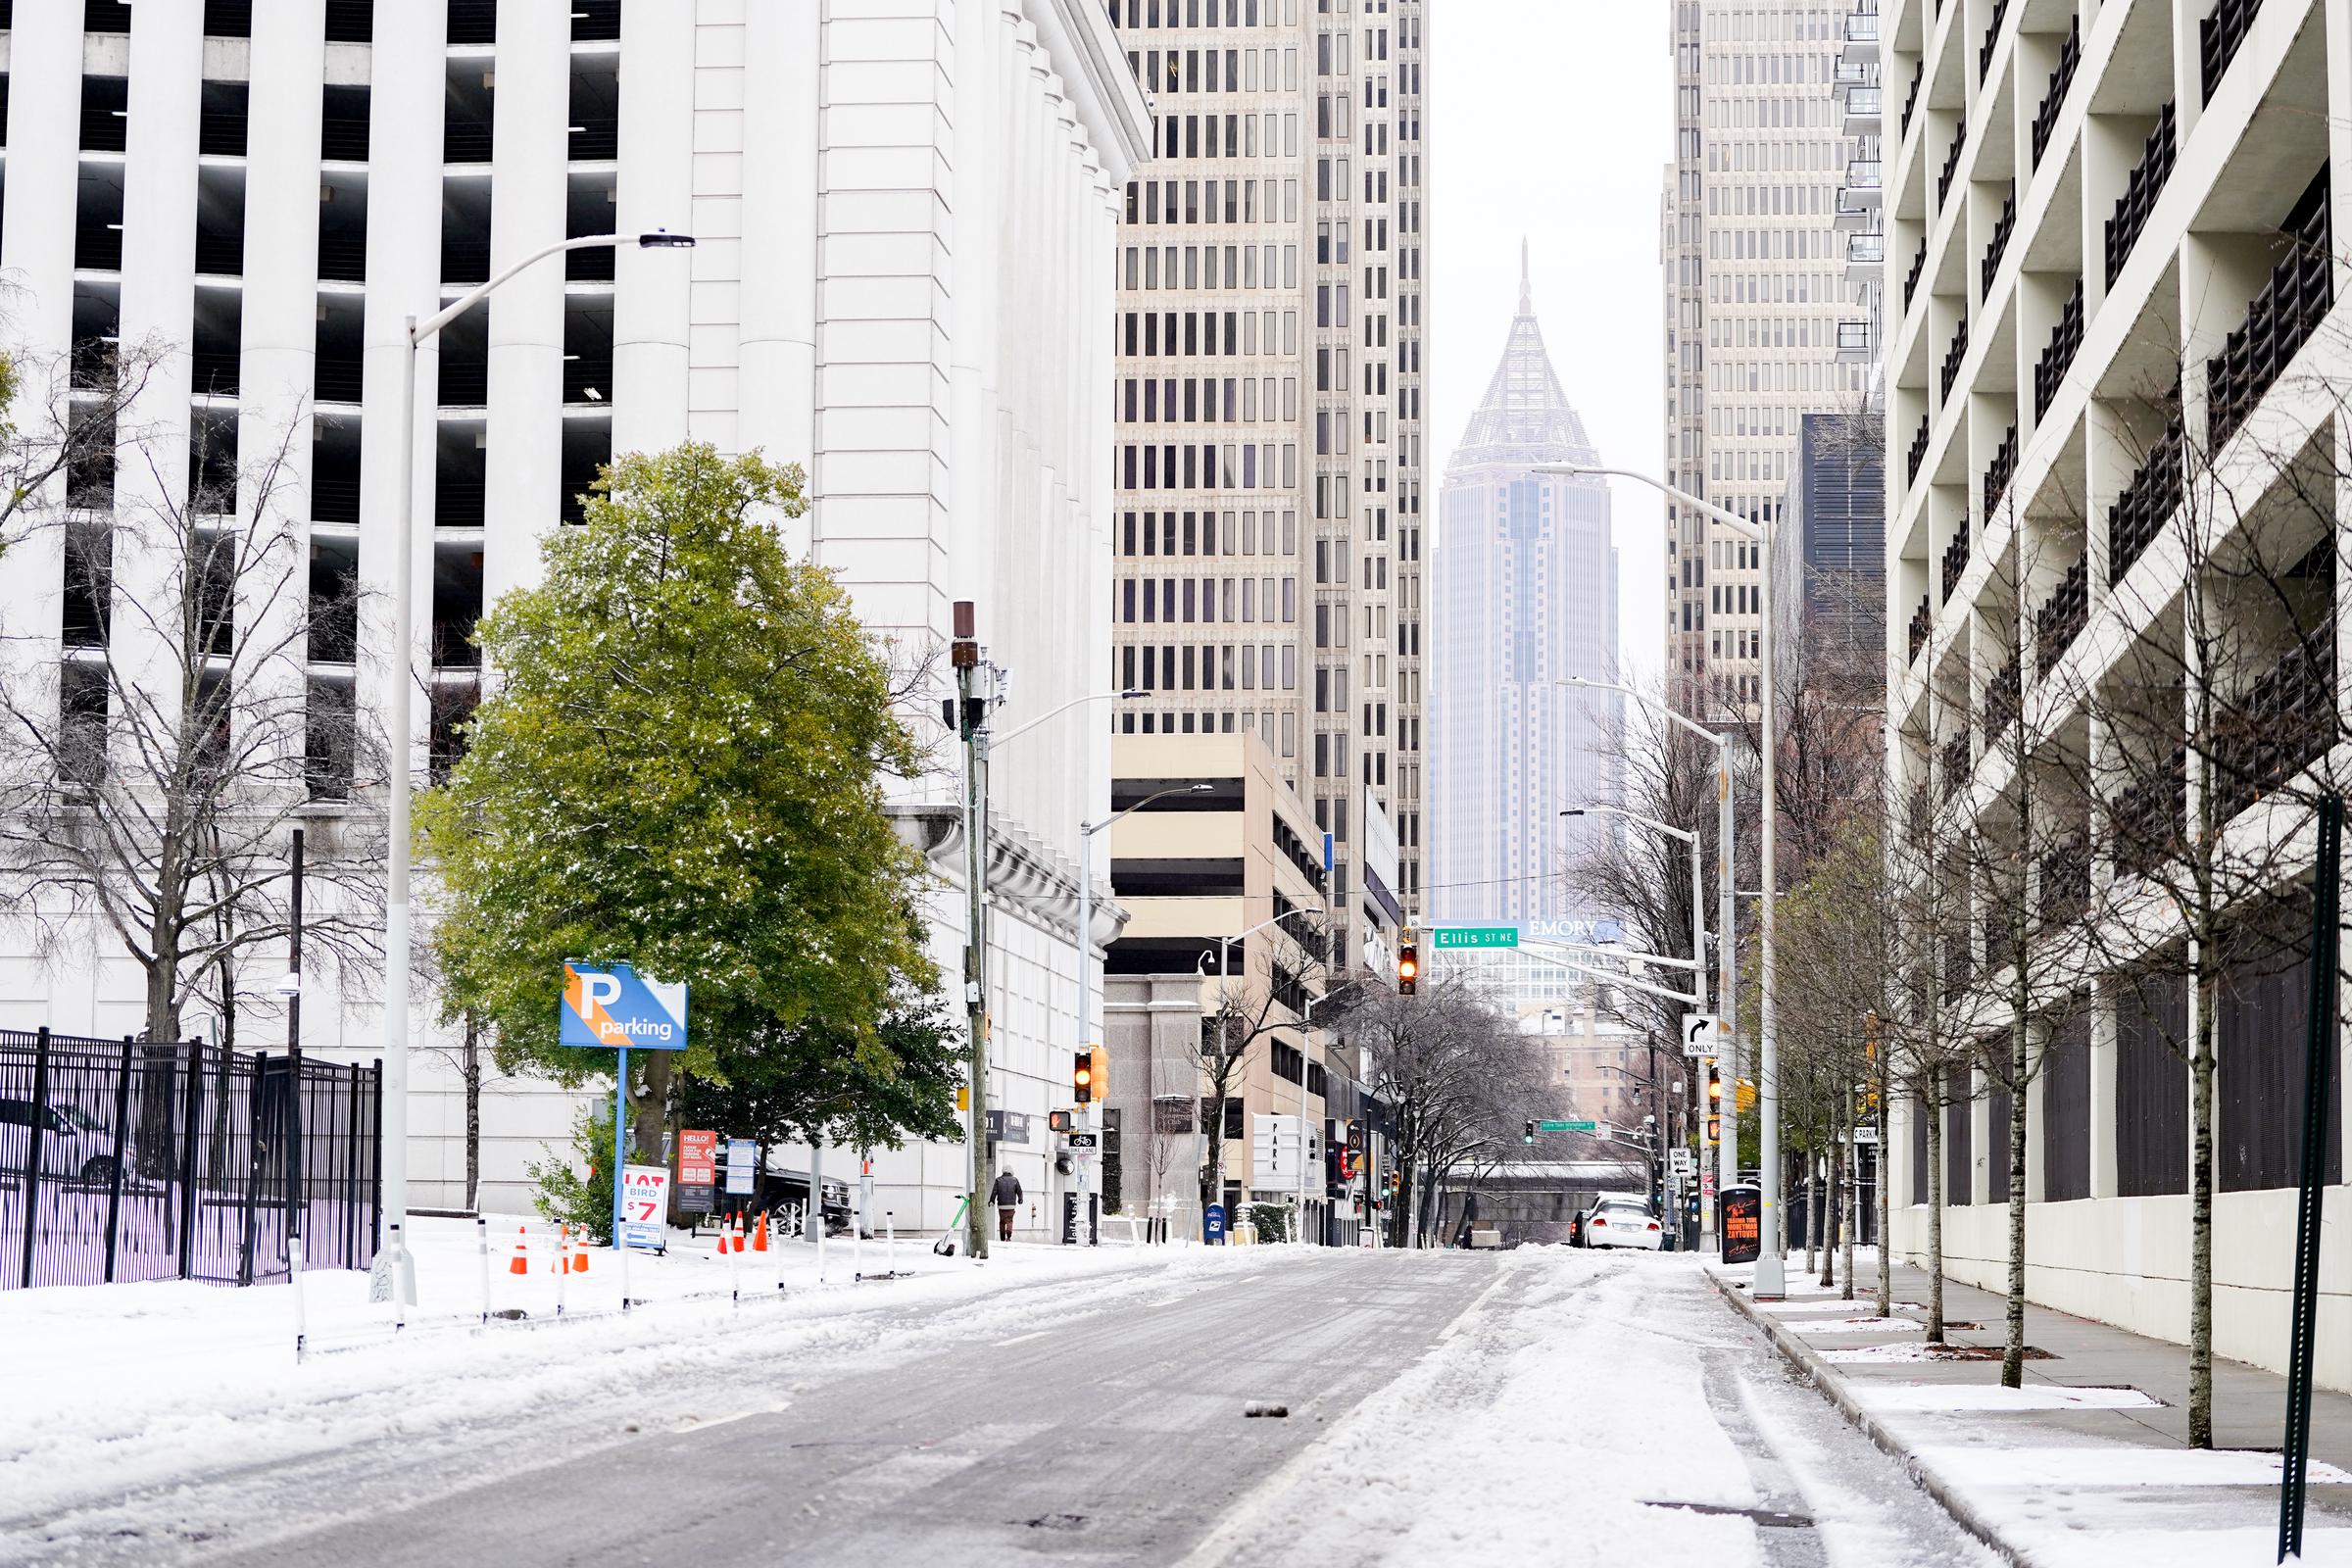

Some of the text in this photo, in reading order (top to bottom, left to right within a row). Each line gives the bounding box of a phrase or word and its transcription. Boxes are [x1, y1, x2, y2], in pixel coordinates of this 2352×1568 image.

[1529, 920, 1598, 936] EMORY
[1440, 932, 1512, 944] Ellis ST NE
[576, 973, 621, 1019] P
[601, 1017, 671, 1041] parking
[630, 1188, 658, 1198] BIRD
